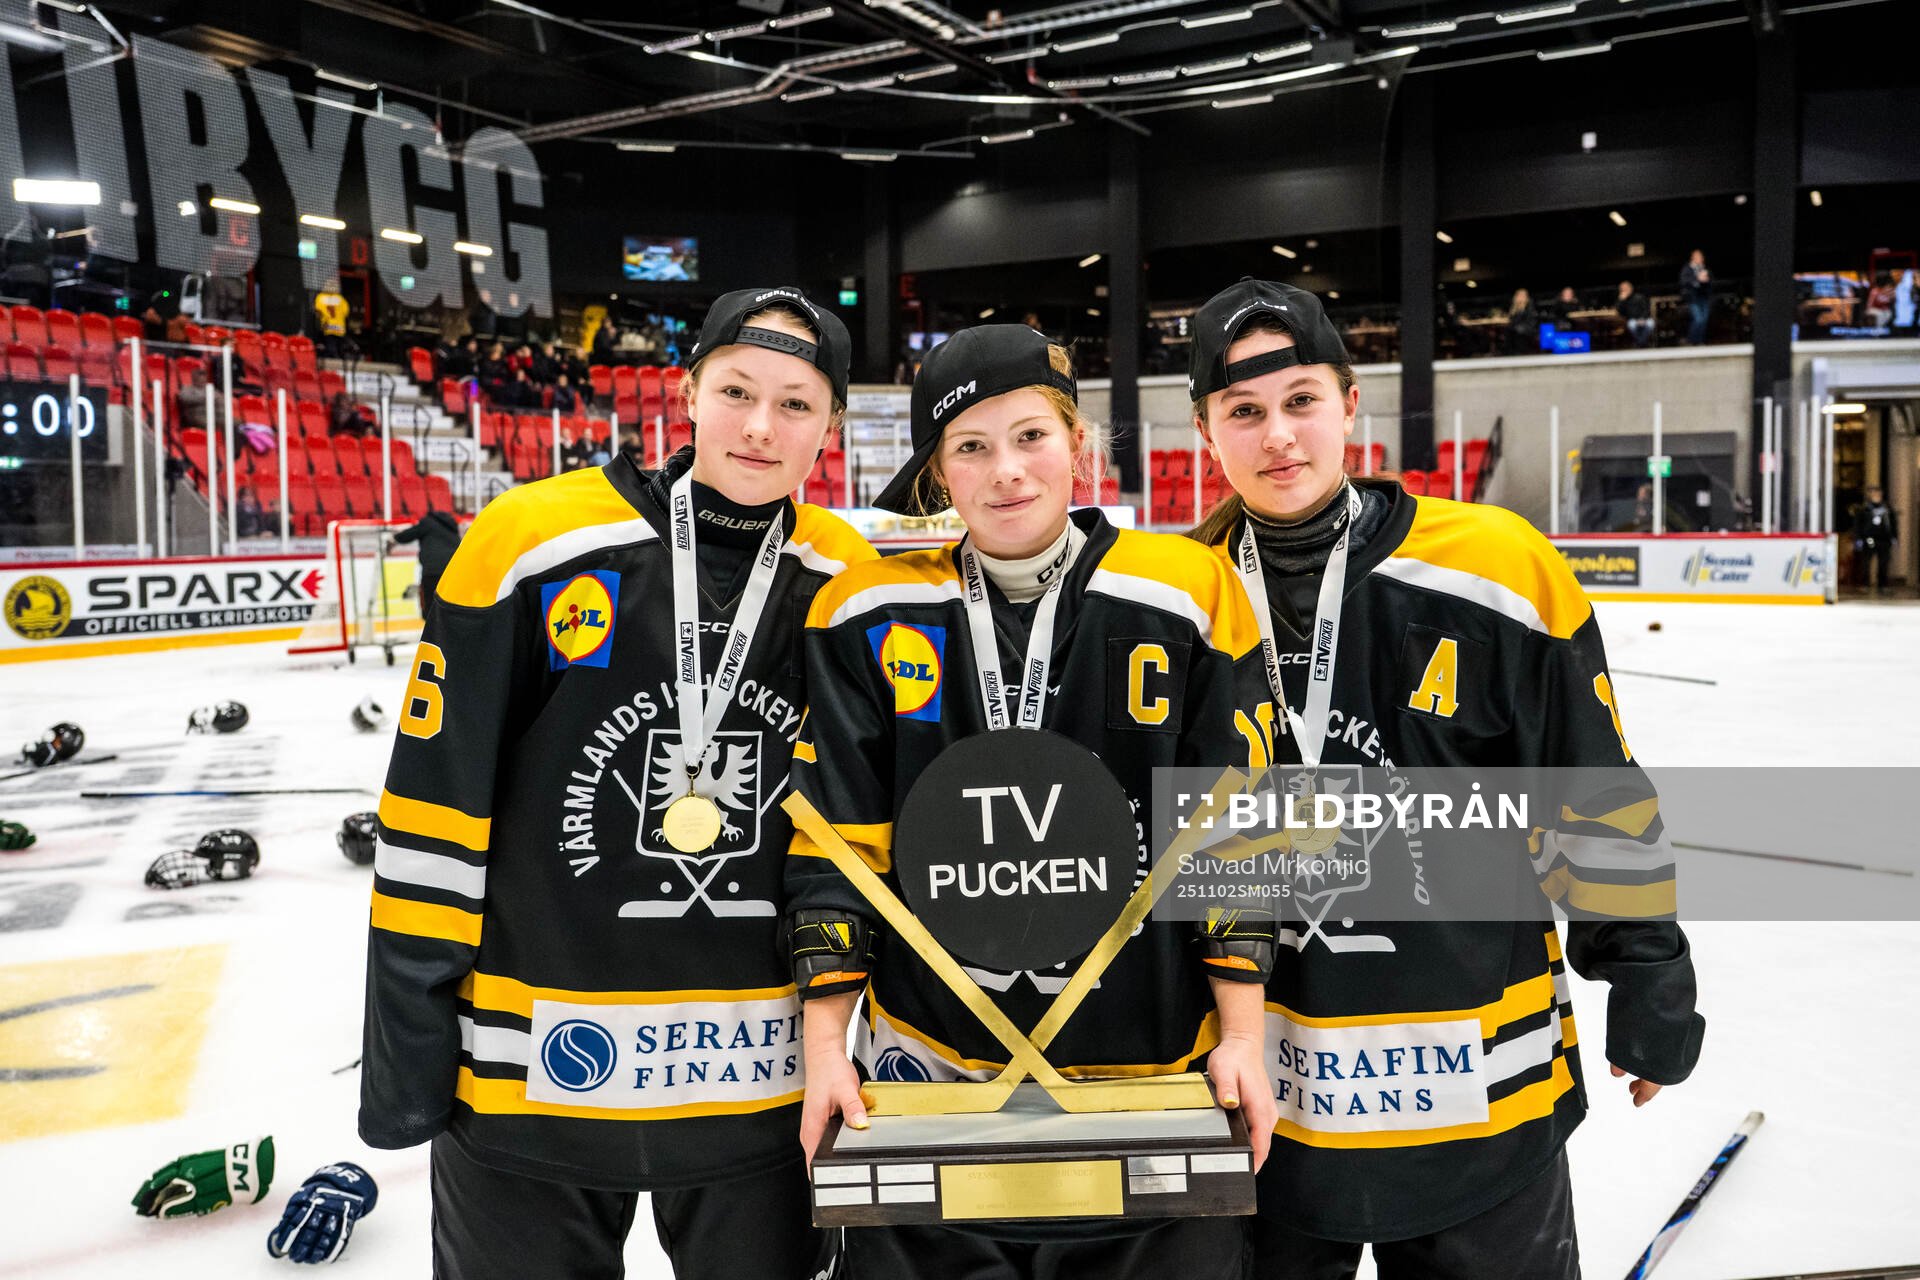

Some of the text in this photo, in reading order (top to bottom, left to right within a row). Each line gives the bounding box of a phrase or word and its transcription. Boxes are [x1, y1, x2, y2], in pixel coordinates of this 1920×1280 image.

[932, 380, 976, 420] CCM
[1037, 538, 1069, 584] CC
[88, 569, 303, 611] SPARX
[84, 615, 193, 634] OFFICIELL
[698, 621, 731, 634] CC
[1279, 653, 1311, 665] CC
[1408, 637, 1460, 718] A
[1128, 643, 1170, 725] C
[558, 691, 659, 878] VÄRMLANDS
[962, 783, 1063, 845] TV
[929, 856, 1108, 899] PUCKEN
[635, 1010, 804, 1054] SERAFI
[634, 1055, 797, 1089] FINANS
[1278, 1038, 1474, 1081] SERAFIM
[1276, 1078, 1433, 1116] FINANS
